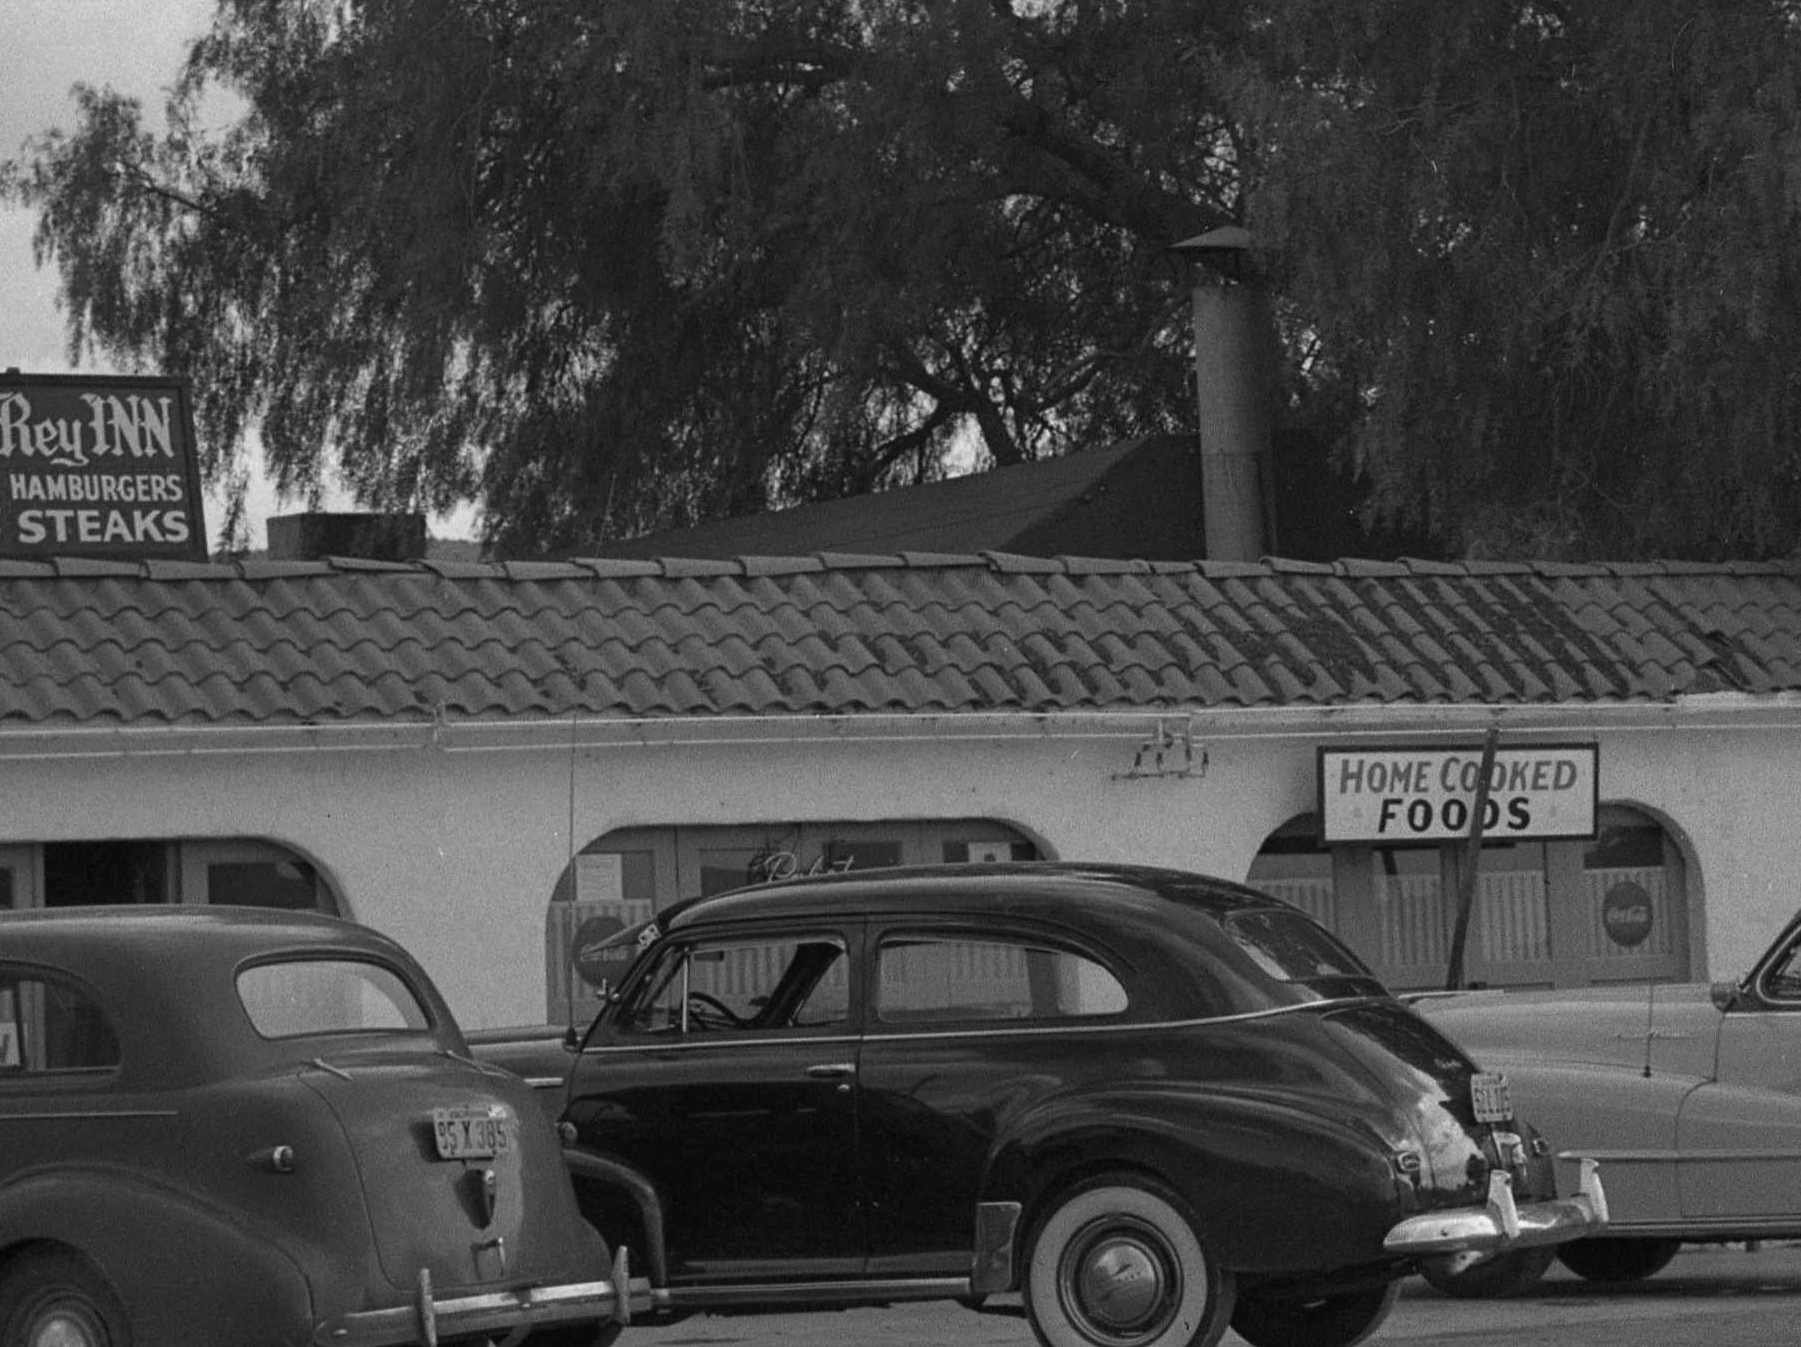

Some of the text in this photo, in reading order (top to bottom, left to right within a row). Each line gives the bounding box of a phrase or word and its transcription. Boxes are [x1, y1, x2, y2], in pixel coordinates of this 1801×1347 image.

[80, 392, 175, 459] INN
[9, 474, 183, 502] HAMBURGERS
[17, 509, 190, 544] STEAKS
[1339, 756, 1578, 795] HOME COOKED
[1378, 796, 1531, 834] FOODS
